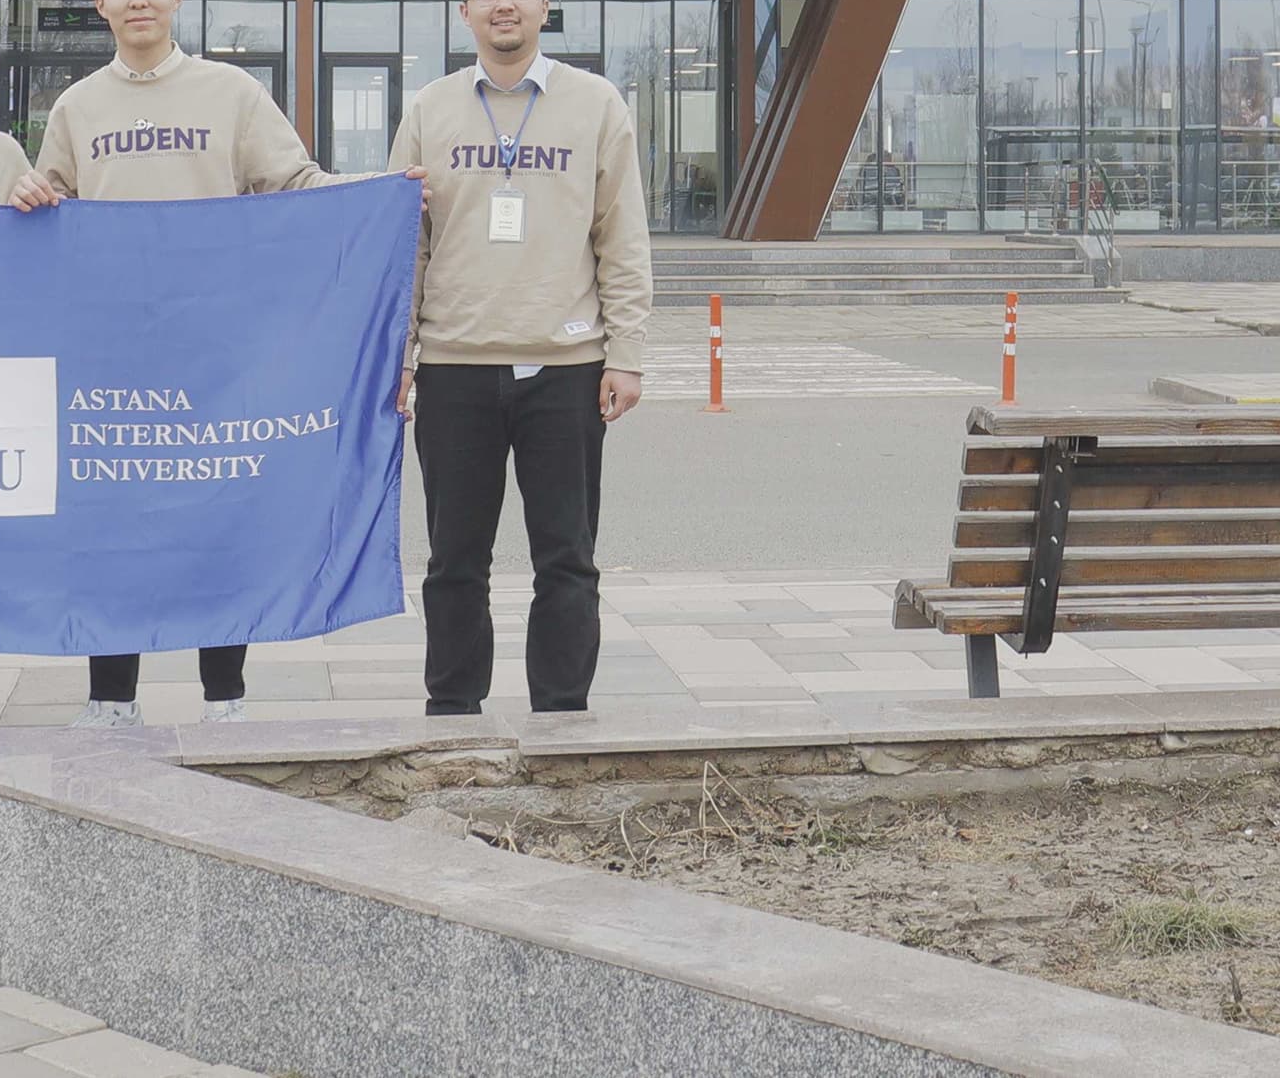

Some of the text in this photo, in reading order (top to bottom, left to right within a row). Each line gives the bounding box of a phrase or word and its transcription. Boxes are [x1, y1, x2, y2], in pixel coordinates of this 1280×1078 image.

[91, 127, 211, 160] STUDENT
[68, 388, 193, 411] ASTANA
[70, 407, 339, 447] INTERNATIONAL
[70, 454, 266, 482] UNIVERSITY
